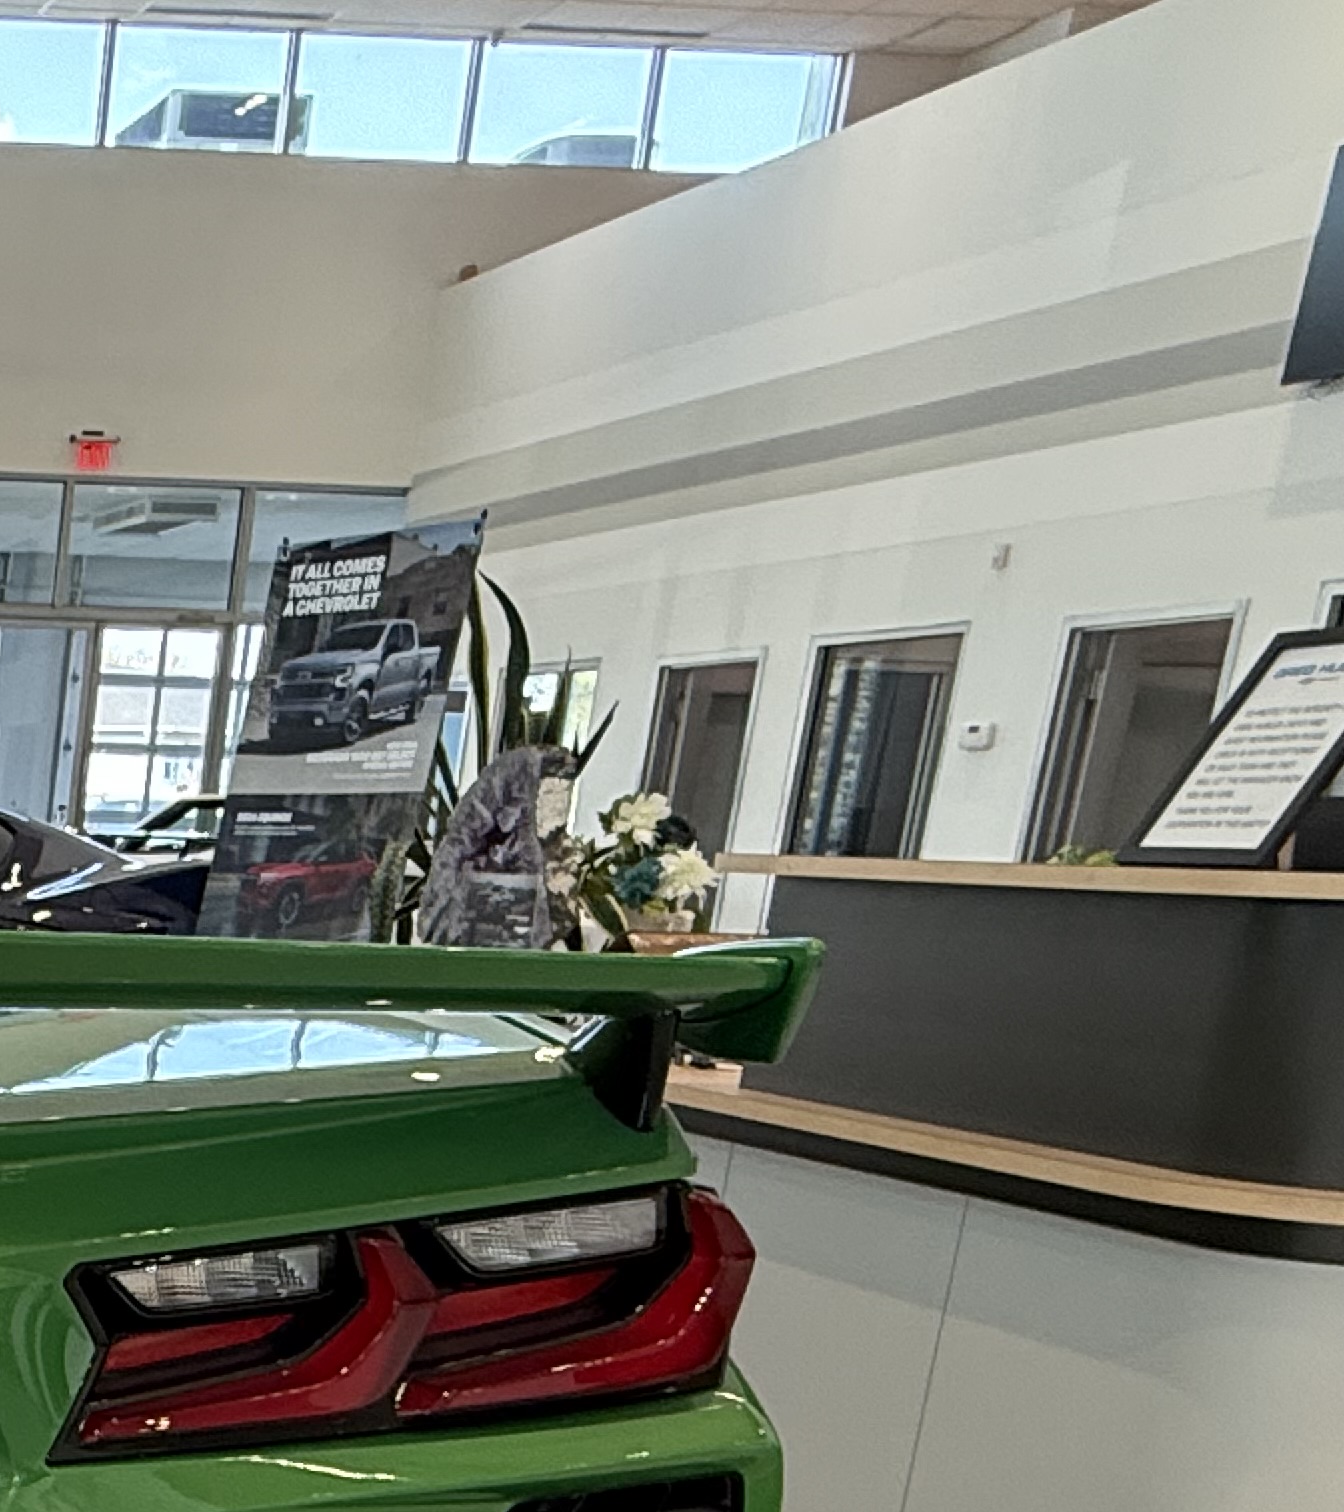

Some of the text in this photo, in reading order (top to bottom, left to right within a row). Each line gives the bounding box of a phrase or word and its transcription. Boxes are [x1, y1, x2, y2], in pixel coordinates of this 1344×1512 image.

[290, 555, 387, 582] IT ALL COMES
[288, 573, 382, 600] TOGETHER IN
[282, 591, 382, 617] A CHEVROLET
